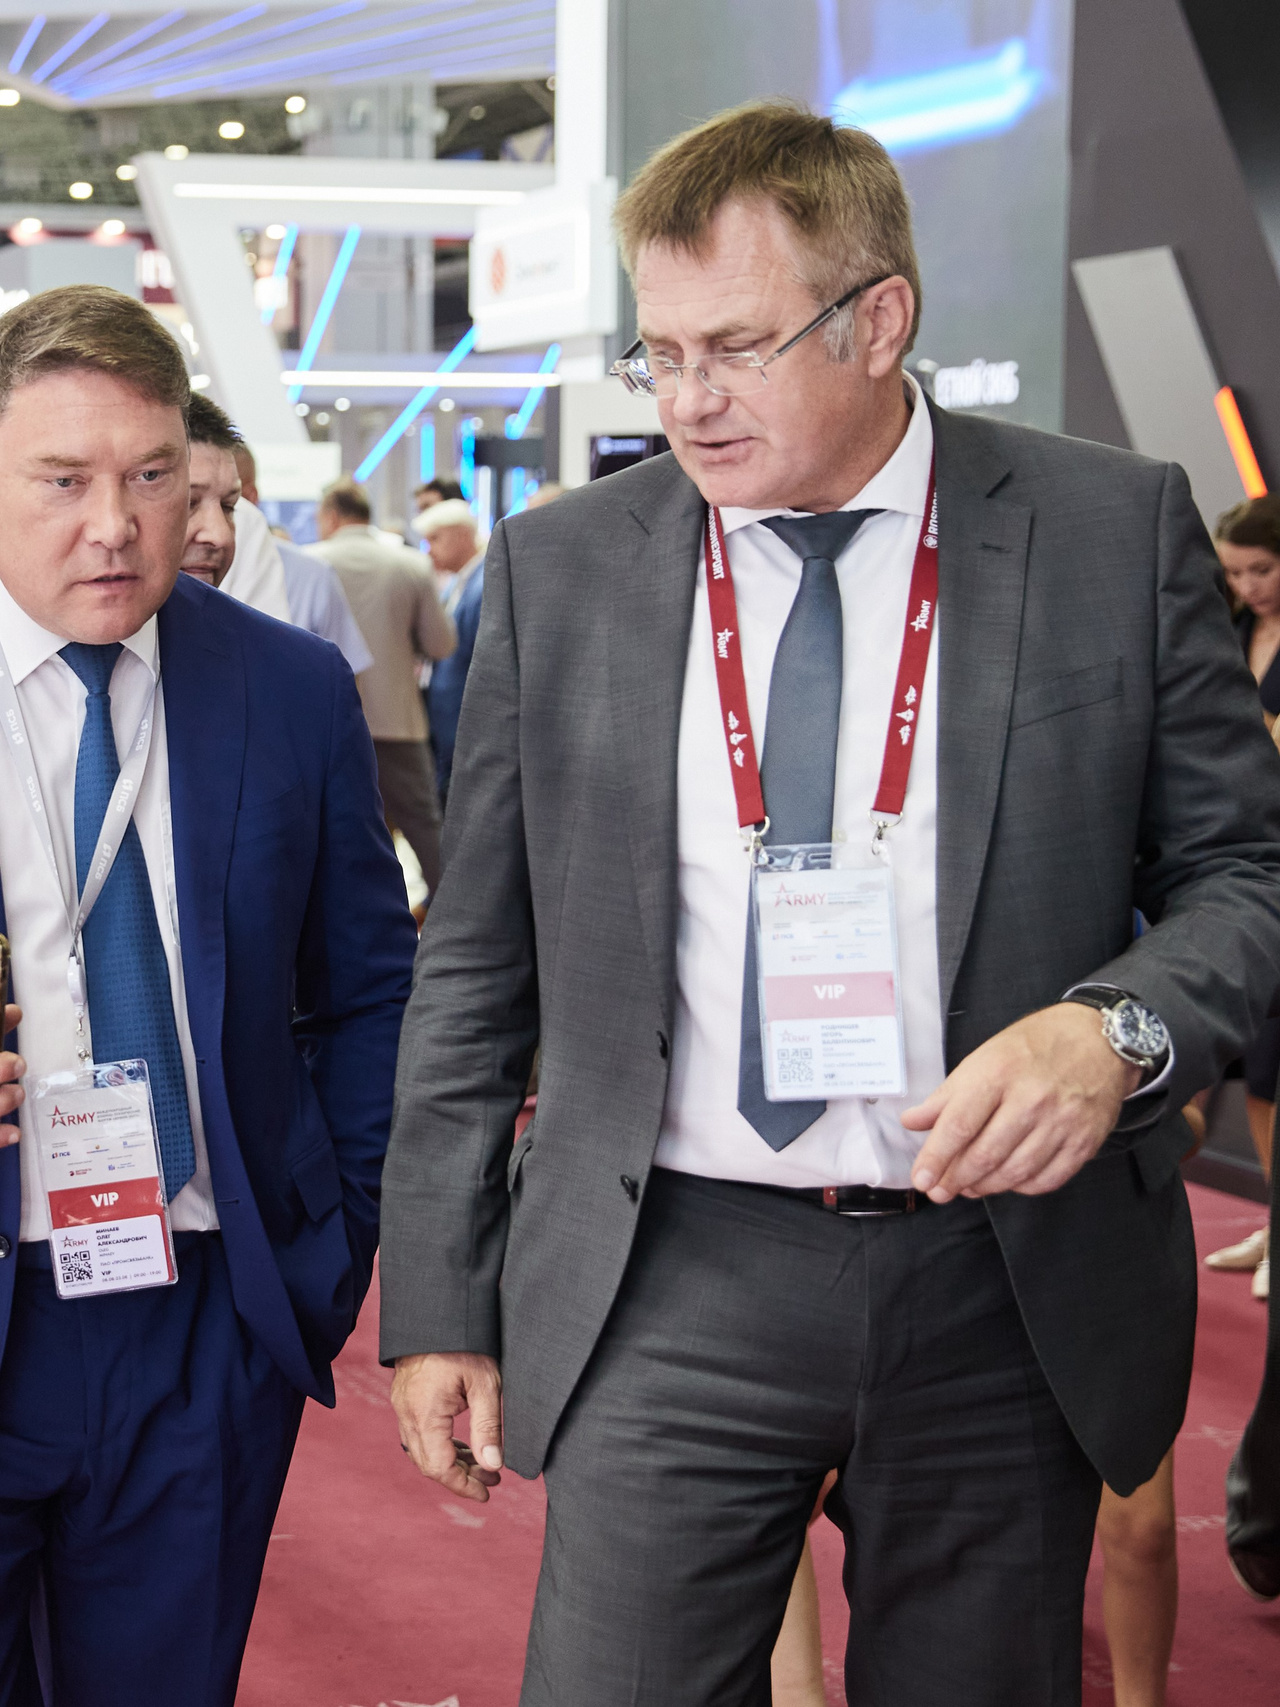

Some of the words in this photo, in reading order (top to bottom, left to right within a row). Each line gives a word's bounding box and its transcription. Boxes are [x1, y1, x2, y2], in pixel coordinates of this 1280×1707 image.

[771, 882, 826, 908] ARMY
[813, 983, 846, 1000] VIP
[47, 1105, 96, 1129] ARMY
[90, 1191, 119, 1208] VIP
[97, 1235, 148, 1247] АЛЕКСАНДРОВИЧ
